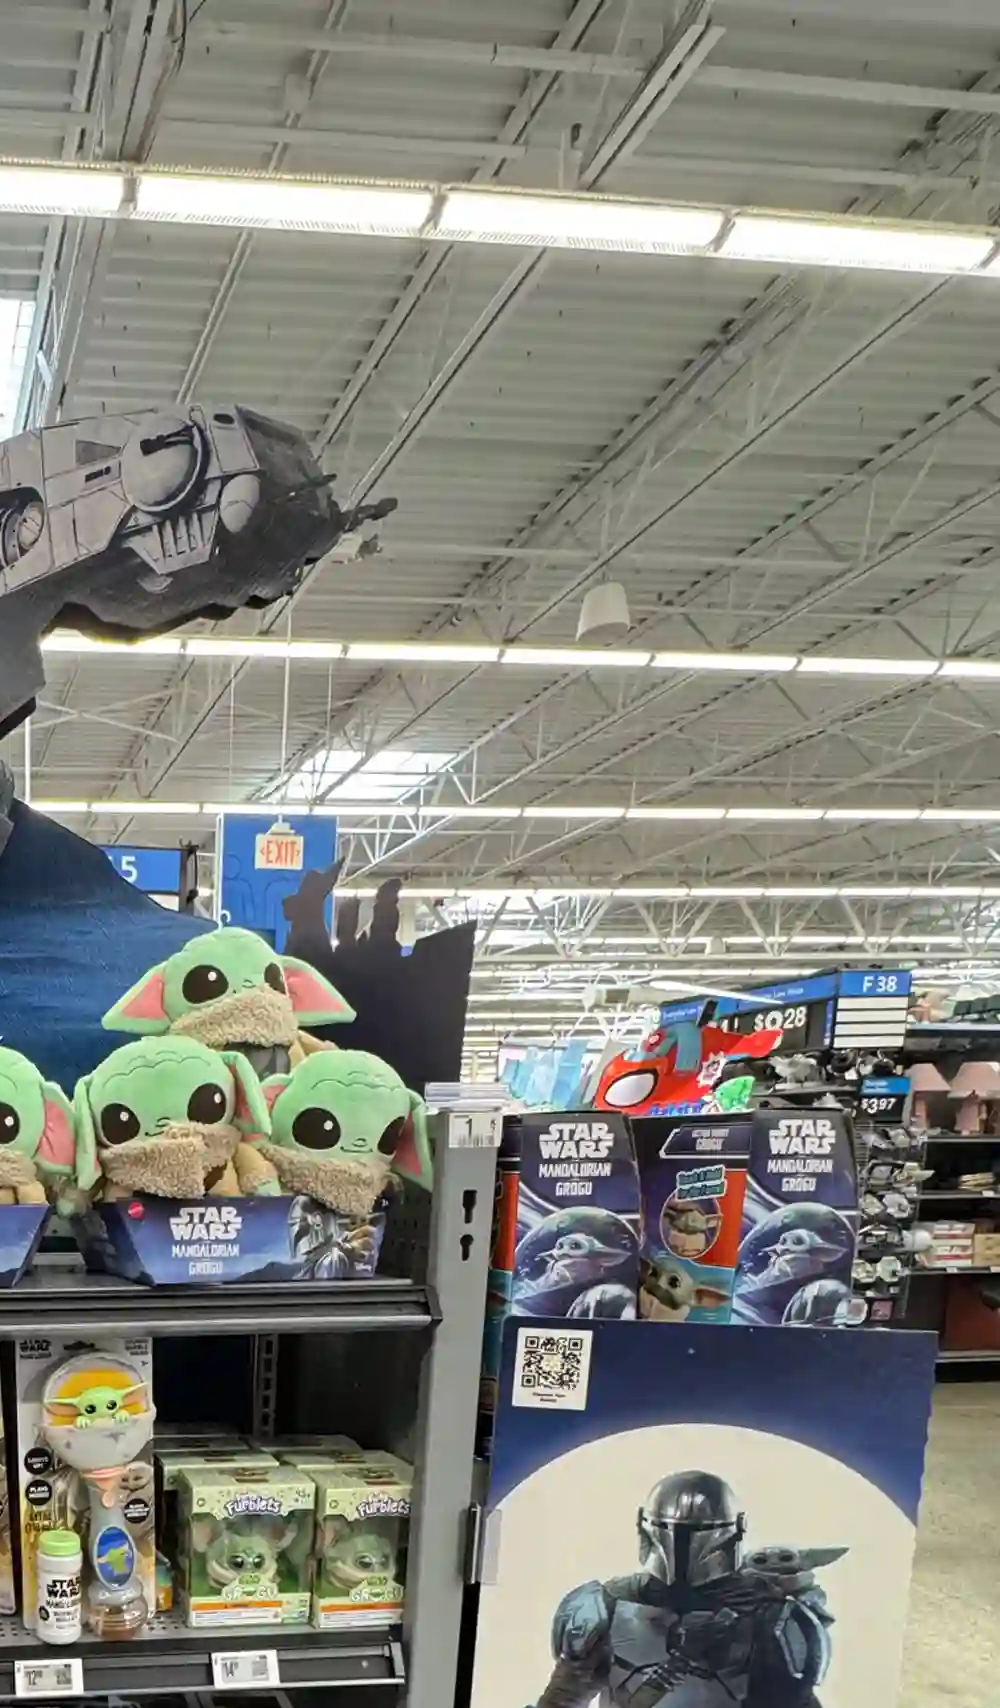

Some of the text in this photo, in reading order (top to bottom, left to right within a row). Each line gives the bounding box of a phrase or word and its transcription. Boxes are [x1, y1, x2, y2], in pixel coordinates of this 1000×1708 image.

[265, 840, 297, 866] EXIT
[863, 975, 898, 993] F 38
[539, 1122, 615, 1141] STAR
[768, 1118, 836, 1137] STAR
[539, 1139, 614, 1160] WARS
[769, 1134, 836, 1156] WARS
[538, 1162, 612, 1179] MANDALORIAN
[767, 1159, 833, 1174] MANDALORIAN
[555, 1181, 593, 1197] GROGU
[781, 1177, 817, 1193] GROGU
